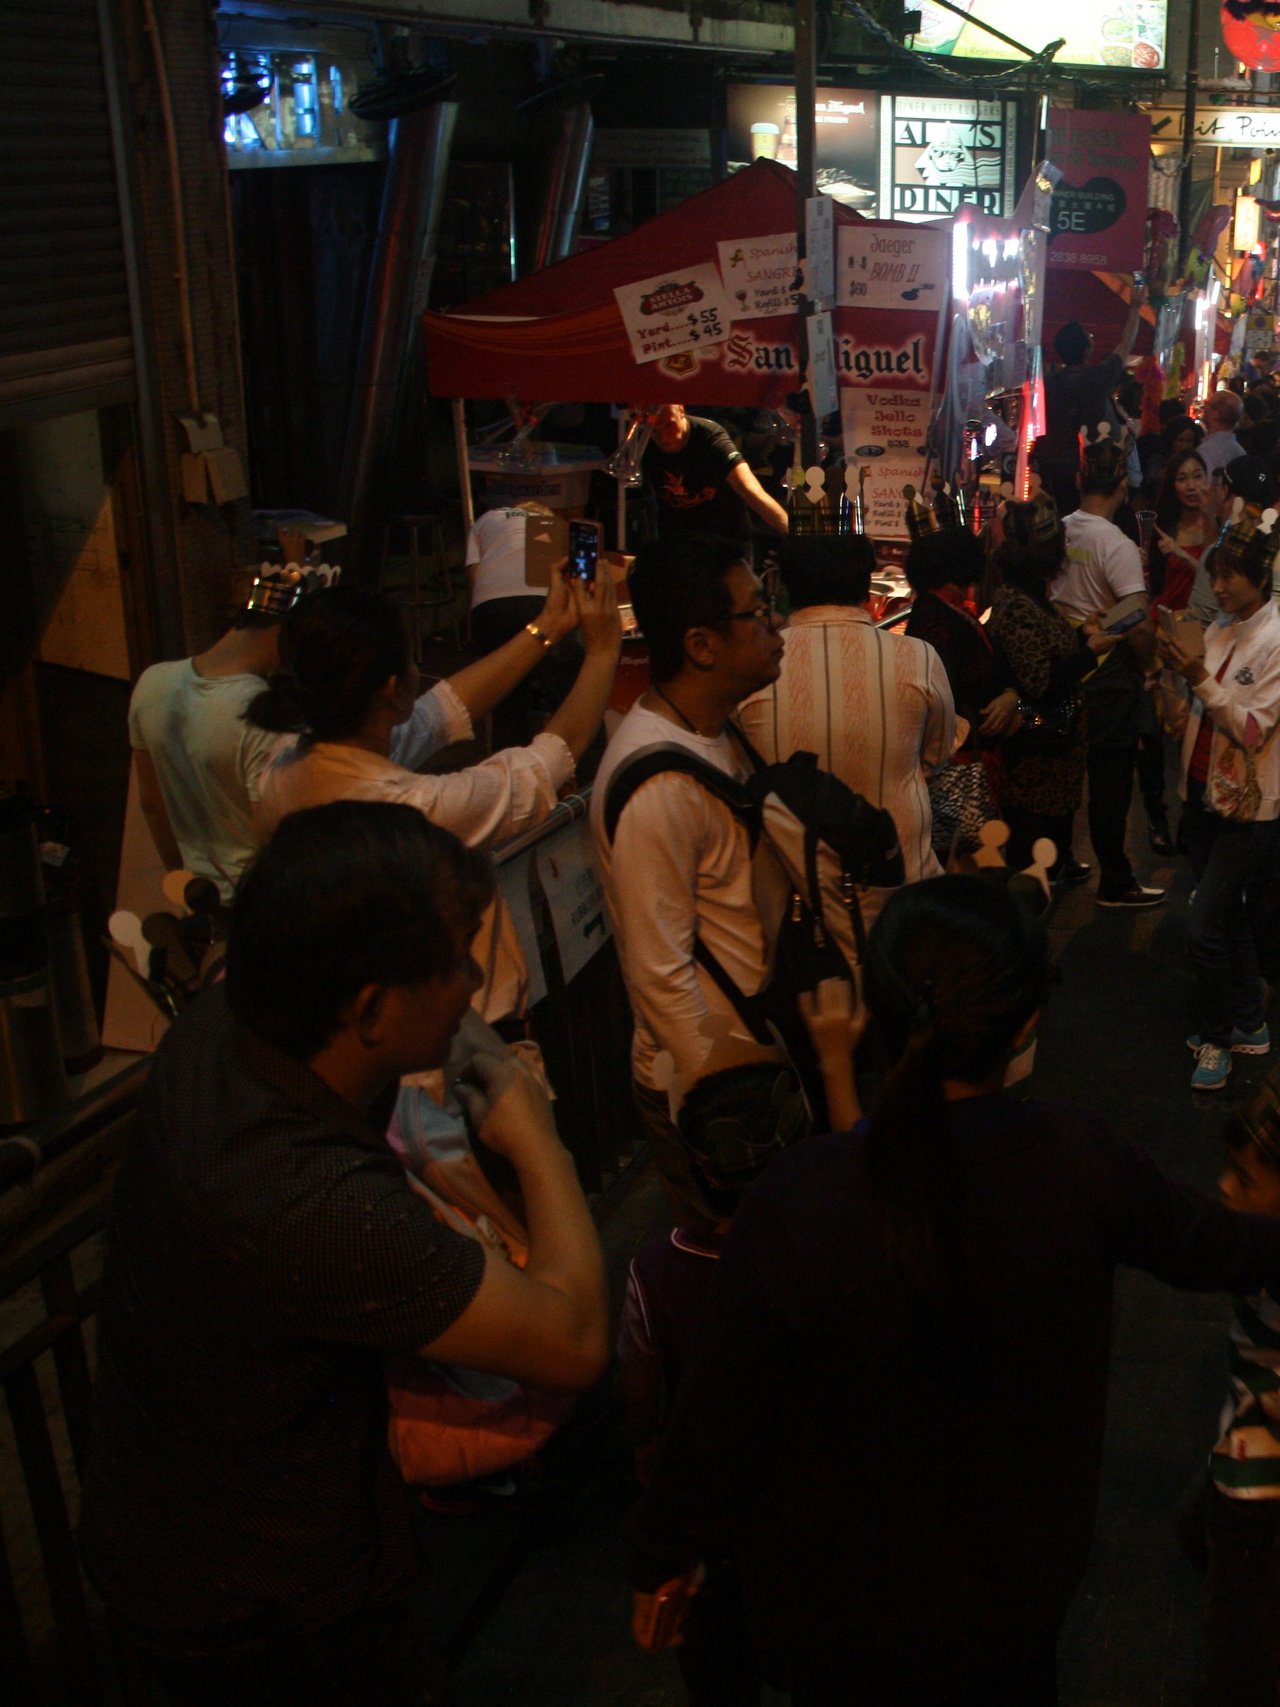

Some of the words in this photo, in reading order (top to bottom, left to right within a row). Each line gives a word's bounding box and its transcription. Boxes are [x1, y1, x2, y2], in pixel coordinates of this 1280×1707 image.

[1056, 210, 1087, 232] 5E
[870, 233, 916, 258] Jaeger
[868, 262, 907, 283] BOMB
[649, 287, 691, 303] STELLA
[651, 294, 694, 311] ARTOIS
[727, 333, 794, 370] San
[837, 337, 925, 379] iguel
[865, 394, 921, 407] Vodka
[874, 410, 916, 423] Jello
[870, 425, 923, 438] Shots
